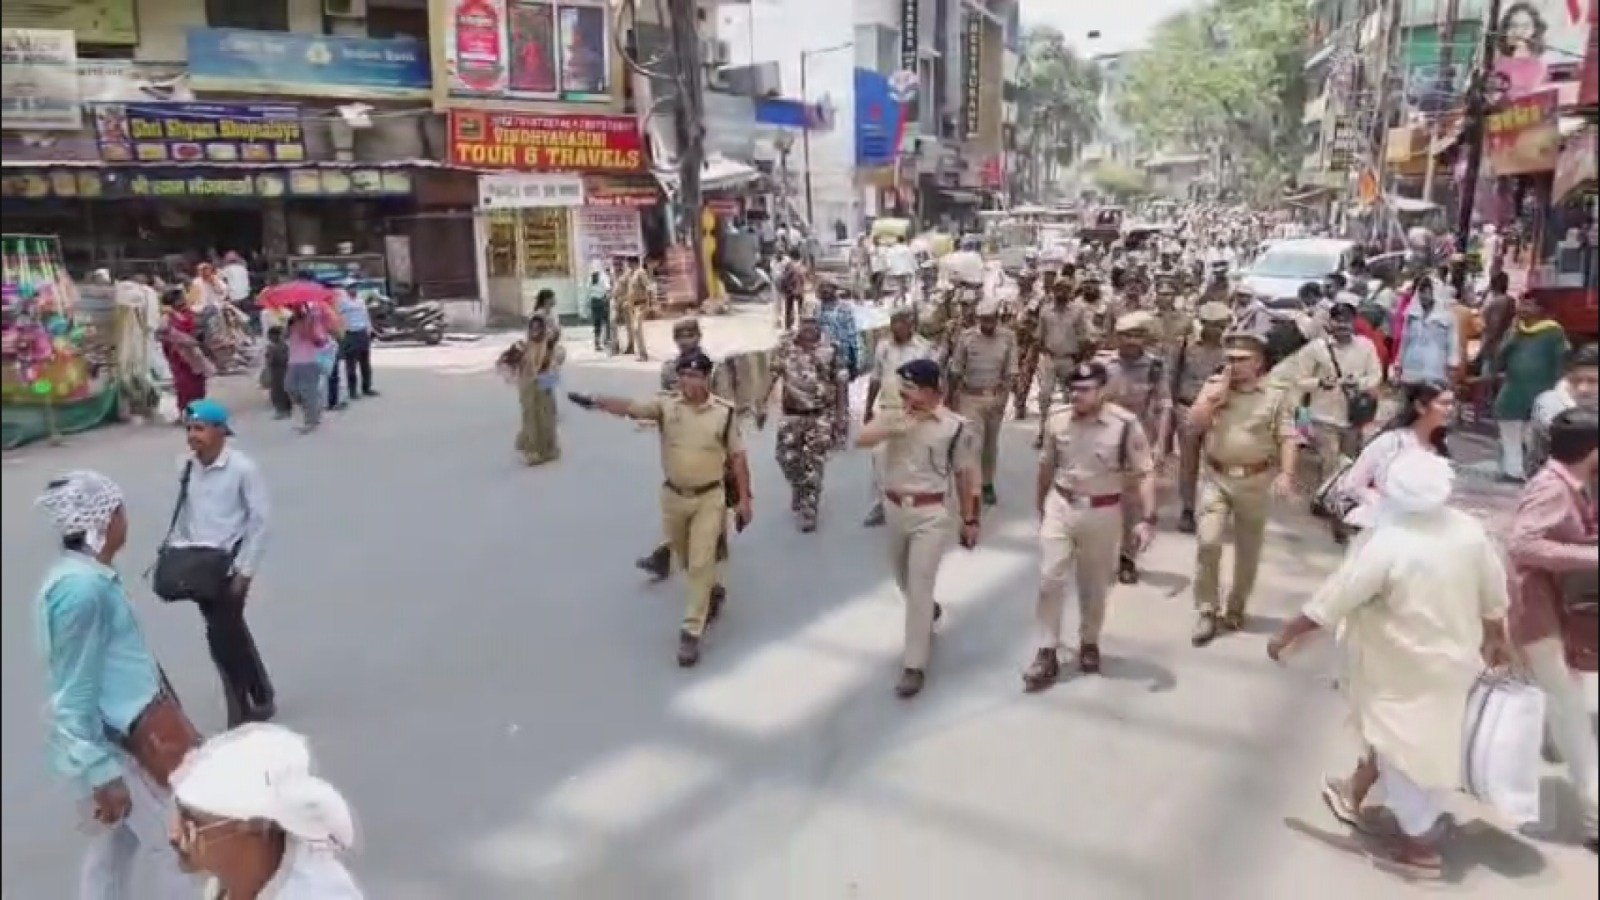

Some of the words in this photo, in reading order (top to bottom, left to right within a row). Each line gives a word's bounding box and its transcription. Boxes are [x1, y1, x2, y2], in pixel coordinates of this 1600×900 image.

[494, 128, 607, 147] VINDHYAVASINI
[457, 143, 516, 165] TOUR
[545, 148, 641, 168] TRAVELS
